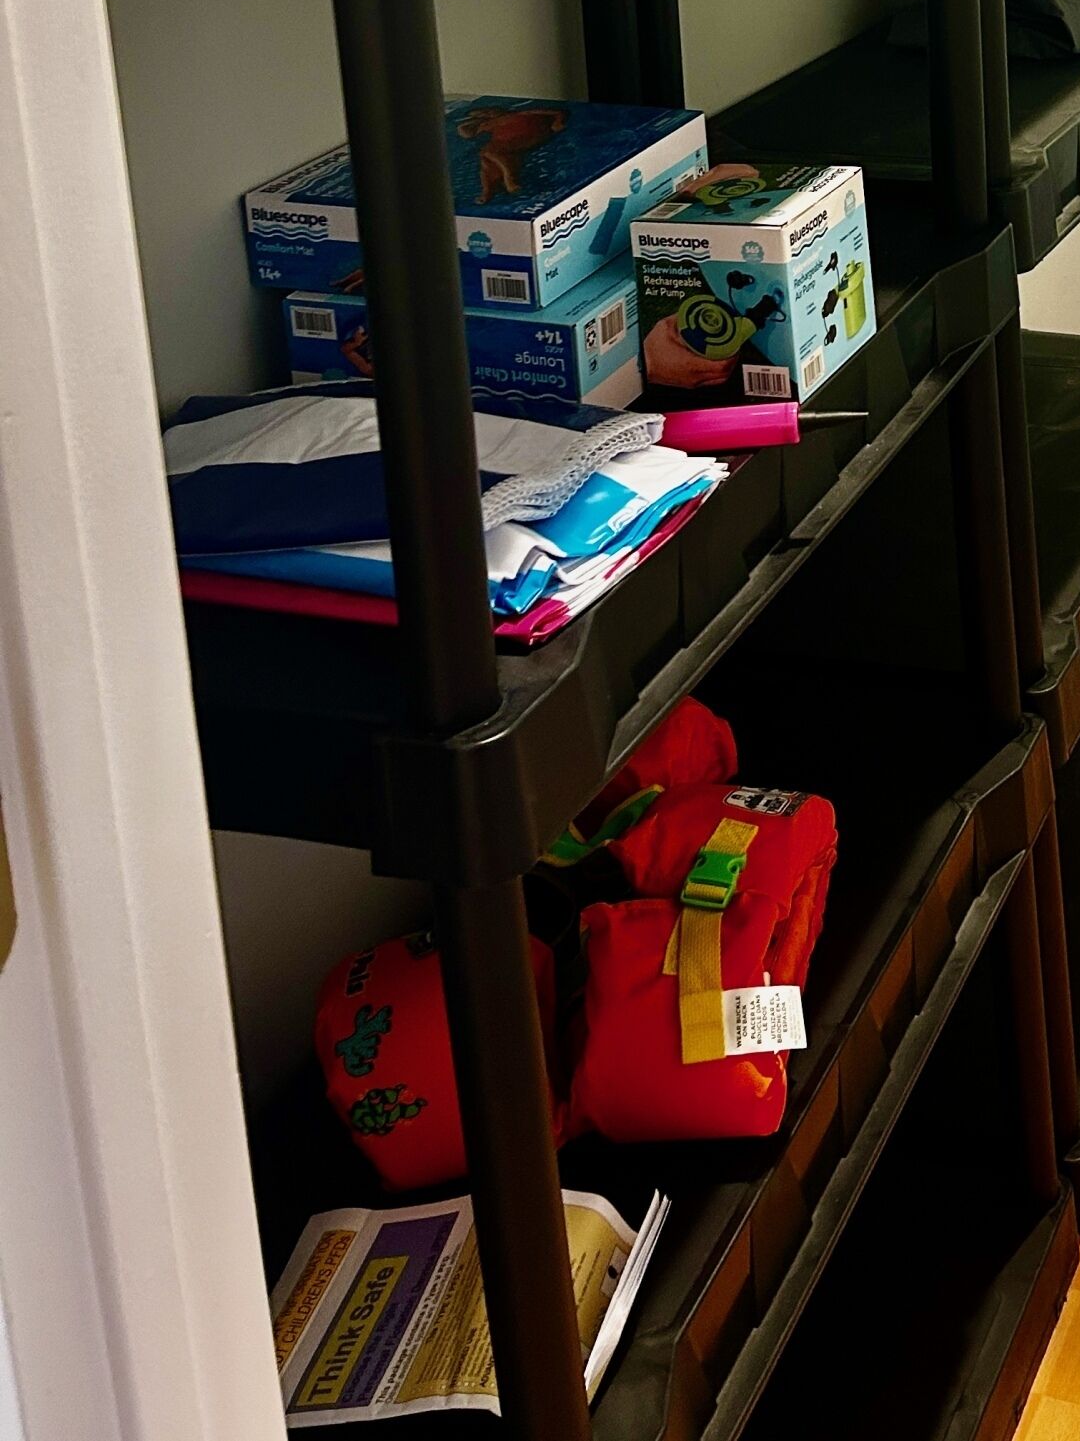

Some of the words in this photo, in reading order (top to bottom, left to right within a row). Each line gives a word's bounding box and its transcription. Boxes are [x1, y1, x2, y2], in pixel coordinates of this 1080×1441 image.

[251, 208, 328, 228] Bluescape
[540, 198, 589, 238] Bluescape
[789, 209, 828, 247] Bluescape
[255, 242, 295, 254] Comfort
[296, 245, 315, 256] Mat
[639, 235, 709, 250] Bluescape
[258, 268, 282, 280] 14+
[546, 267, 559, 282] Mat
[793, 260, 824, 289] Rechargeable
[644, 276, 702, 288] Rechargeable
[802, 280, 817, 299] Pump
[660, 289, 686, 298] Pump
[535, 329, 563, 344] 14+
[514, 352, 565, 371] Lounge
[475, 366, 509, 381] Chair
[511, 370, 566, 388] Comfort
[750, 1001, 755, 1009] LA
[743, 1026, 747, 1037] ON
[763, 1023, 767, 1031] LE
[287, 1269, 332, 1343] CHILDREN'S
[326, 1237, 351, 1265] PFDs
[309, 1325, 361, 1401] Think
[351, 1267, 394, 1319] Safe
[375, 1387, 391, 1403] This
[387, 1349, 407, 1382] package
